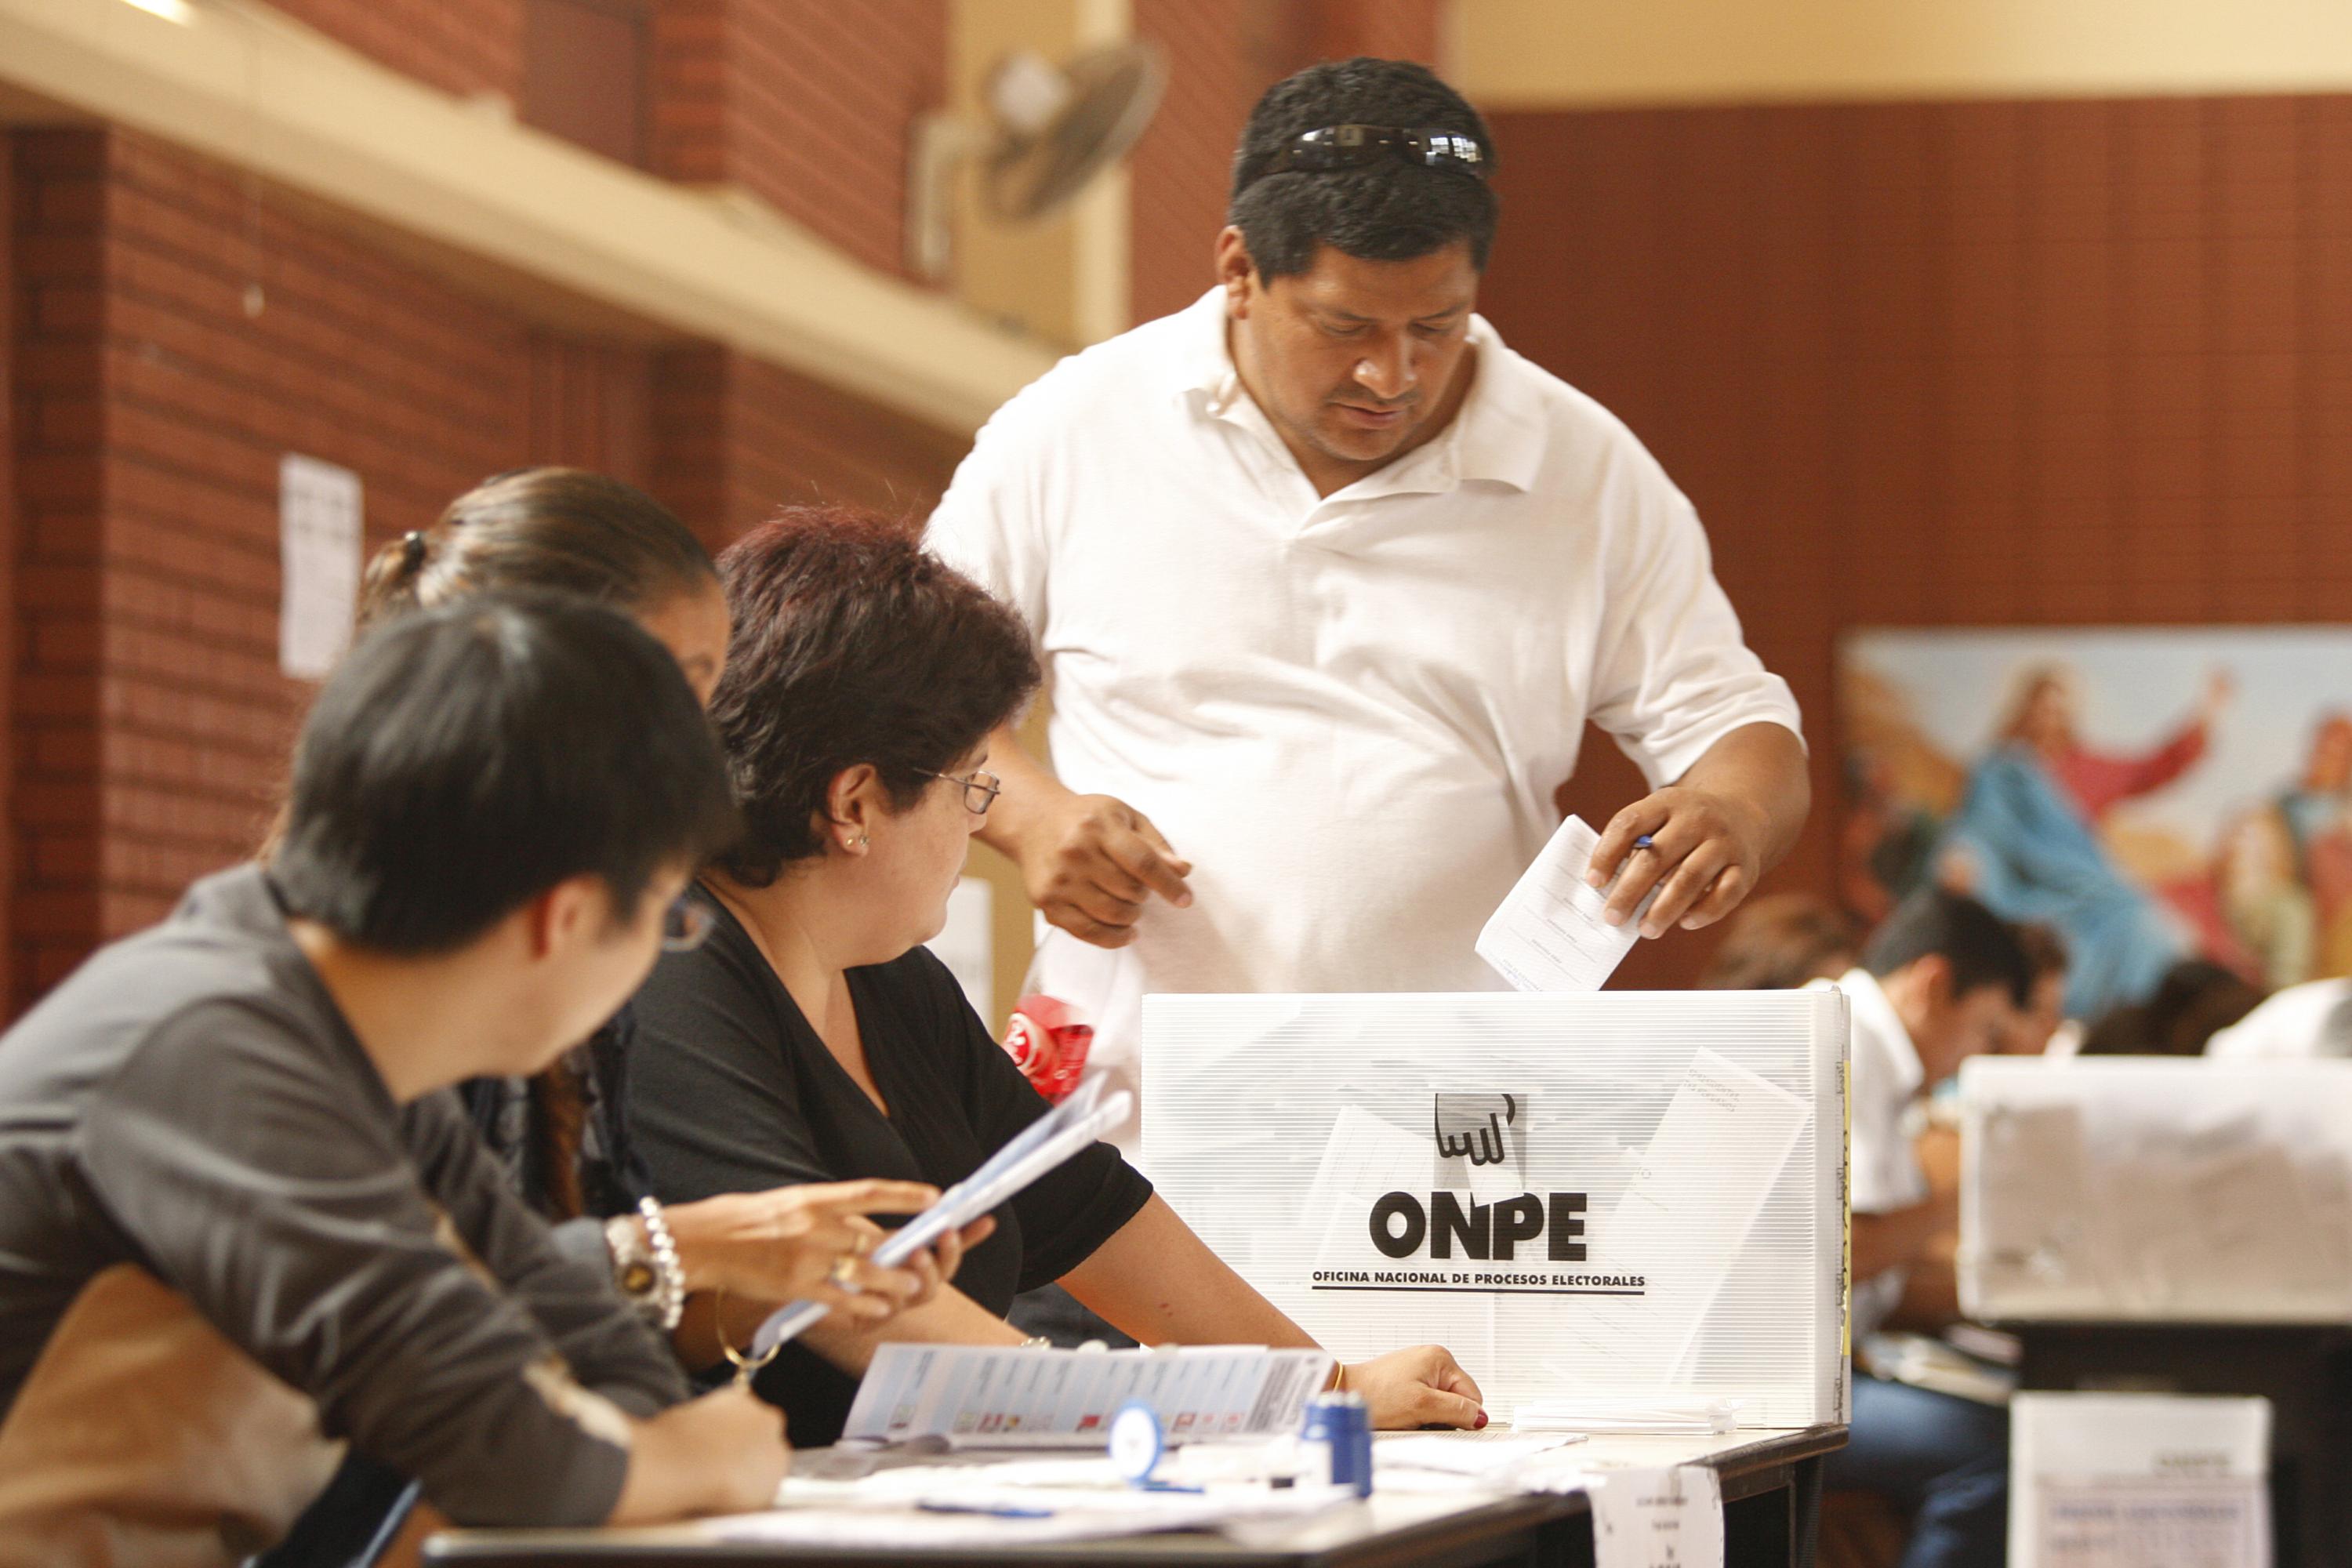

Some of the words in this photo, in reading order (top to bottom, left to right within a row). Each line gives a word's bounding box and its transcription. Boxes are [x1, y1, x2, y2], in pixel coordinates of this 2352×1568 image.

[1369, 1191, 1588, 1261] ONPE
[1312, 1271, 1370, 1283] OFICINA
[1374, 1272, 1447, 1283] NACIONAL
[1452, 1273, 1470, 1284] DE
[1474, 1274, 1547, 1286] PROCESOS
[1552, 1276, 1646, 1287] ELECTORALES
